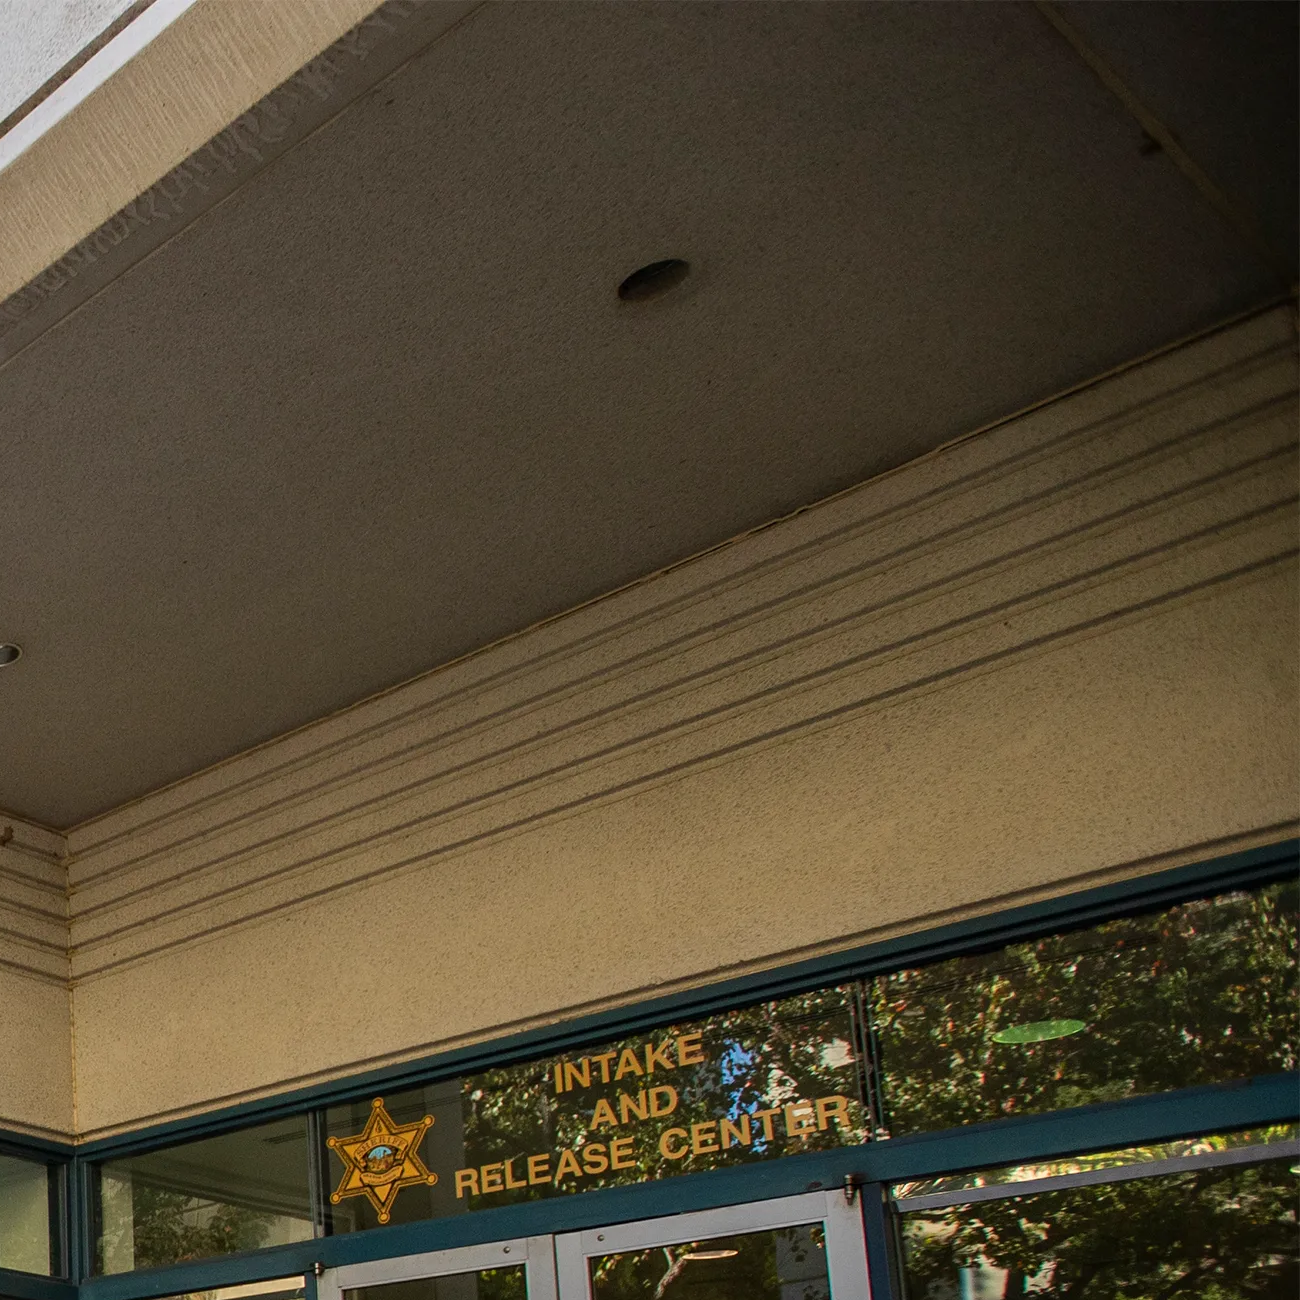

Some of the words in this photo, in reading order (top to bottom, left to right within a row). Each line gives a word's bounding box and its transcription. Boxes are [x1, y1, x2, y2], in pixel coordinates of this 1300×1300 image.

[554, 1033, 705, 1094] INTAKE
[590, 1086, 678, 1131] AND
[357, 1136, 406, 1157] SHERIFF
[454, 1145, 636, 1199] RELEASE
[659, 1095, 850, 1159] CENTER
